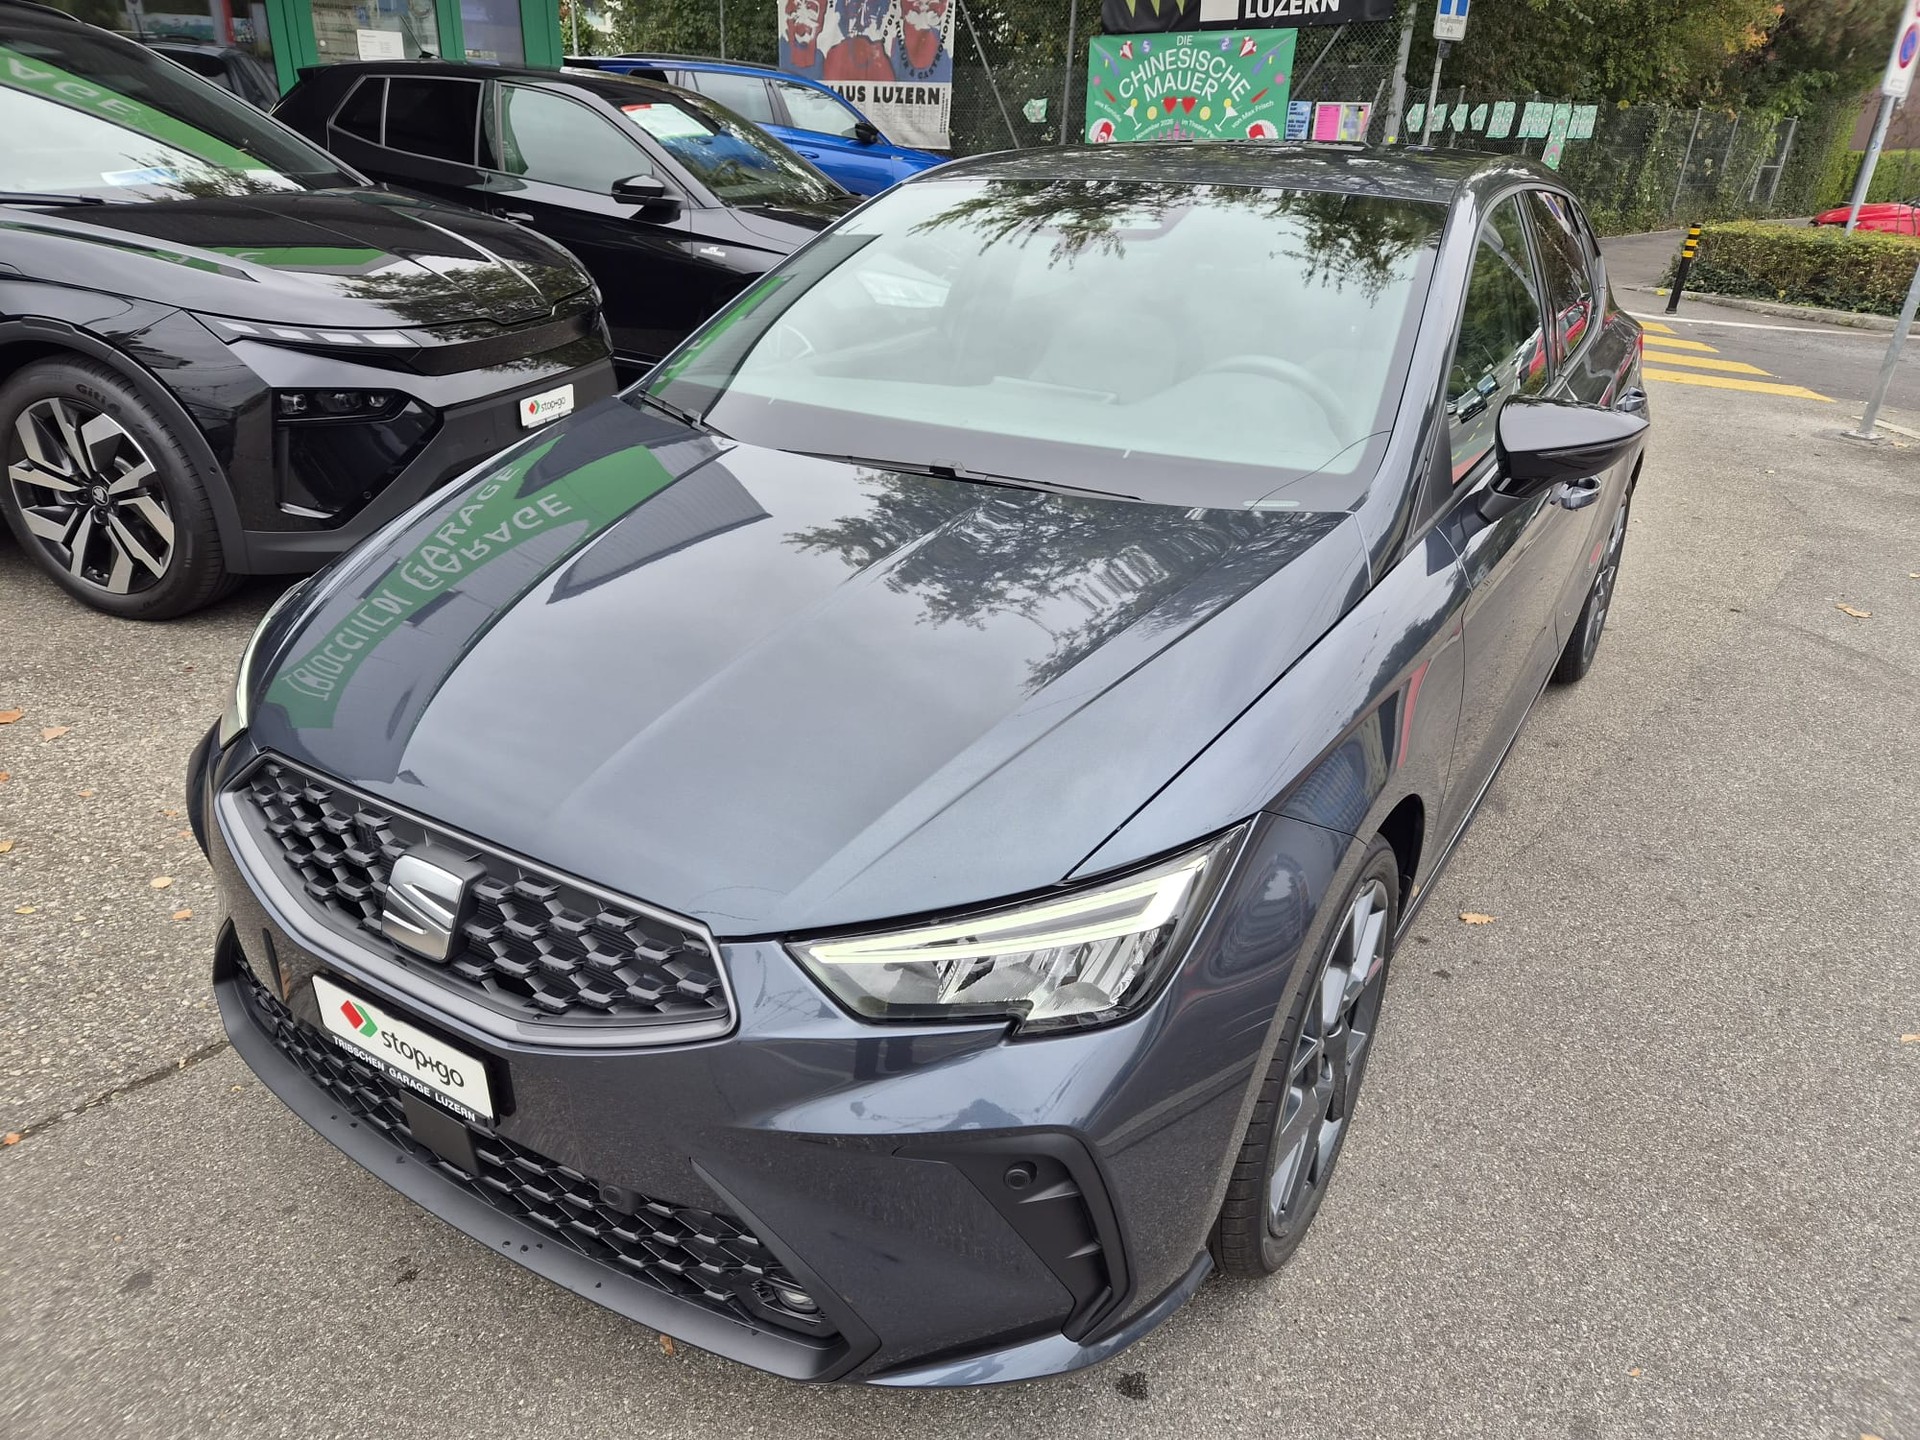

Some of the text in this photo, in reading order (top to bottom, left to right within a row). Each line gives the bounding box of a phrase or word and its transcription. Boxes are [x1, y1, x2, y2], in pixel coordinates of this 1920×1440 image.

[1245, 0, 1340, 19] LUZERN
[1176, 35, 1193, 46] DIE
[1119, 48, 1251, 102] CHINESISCHE
[1143, 70, 1219, 102] MAUER
[873, 85, 940, 105] LUZERN
[1255, 100, 1274, 112] Frisch
[381, 1030, 465, 1088] stop+go
[332, 1035, 476, 1122] TRIBSCHEN GARAGE LUZERN
